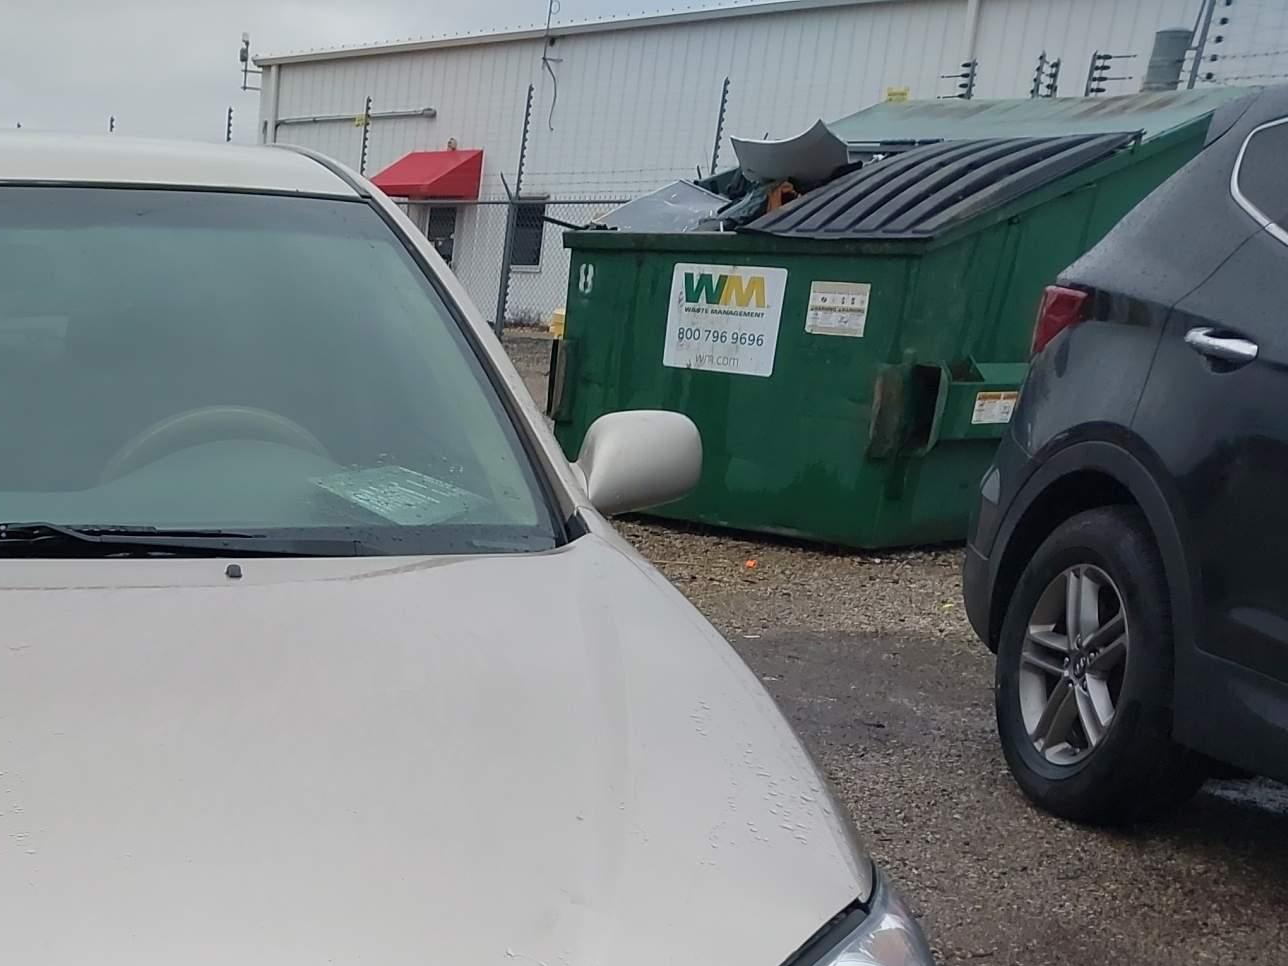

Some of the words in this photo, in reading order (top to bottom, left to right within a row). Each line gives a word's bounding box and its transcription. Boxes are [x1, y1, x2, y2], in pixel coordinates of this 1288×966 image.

[684, 272, 766, 308] WM
[685, 306, 709, 314] WASTE
[710, 308, 765, 318] MANAGEMENT
[678, 327, 701, 341] 800
[704, 329, 728, 344] 796
[731, 331, 765, 347] 9696
[695, 353, 740, 367] wm.com
